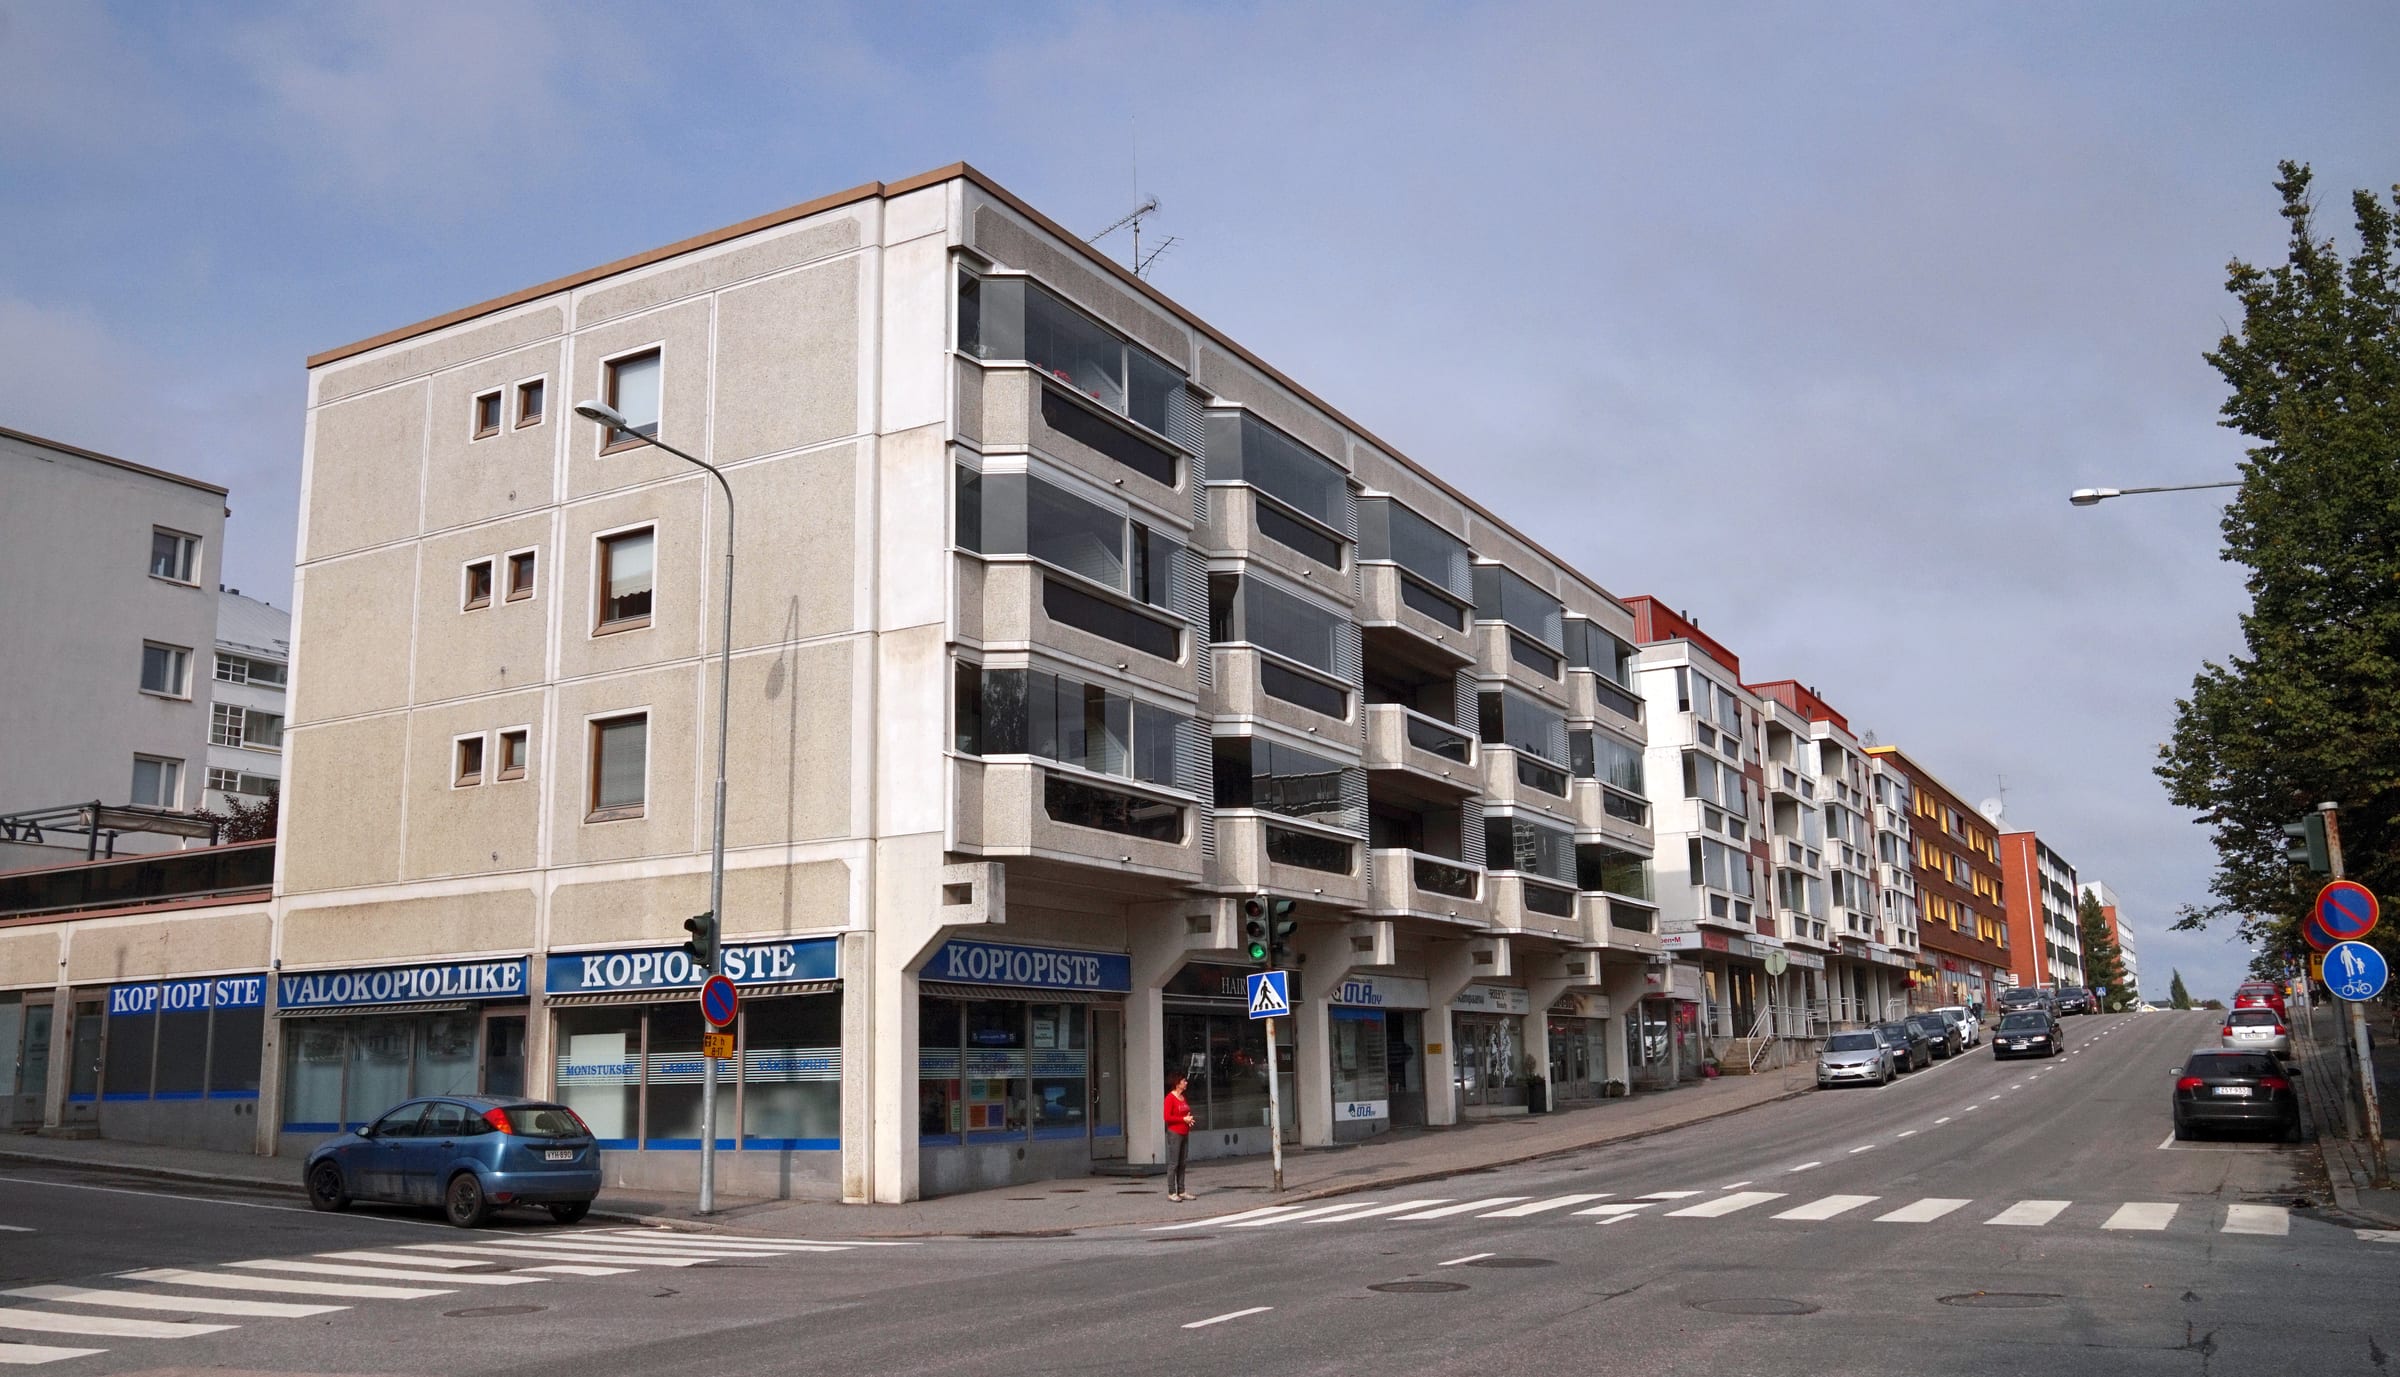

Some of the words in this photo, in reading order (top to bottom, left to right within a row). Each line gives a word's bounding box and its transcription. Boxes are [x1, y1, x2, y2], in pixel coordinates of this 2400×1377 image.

[947, 944, 1100, 986] KOPIOPISTE
[112, 978, 260, 1013] KOPIOPISTE
[282, 961, 521, 1004] VALOKOPIOLIIKE
[1221, 976, 1247, 995] HAIR
[712, 1036, 717, 1046] 2
[566, 1063, 634, 1076] MONISTUKSET
